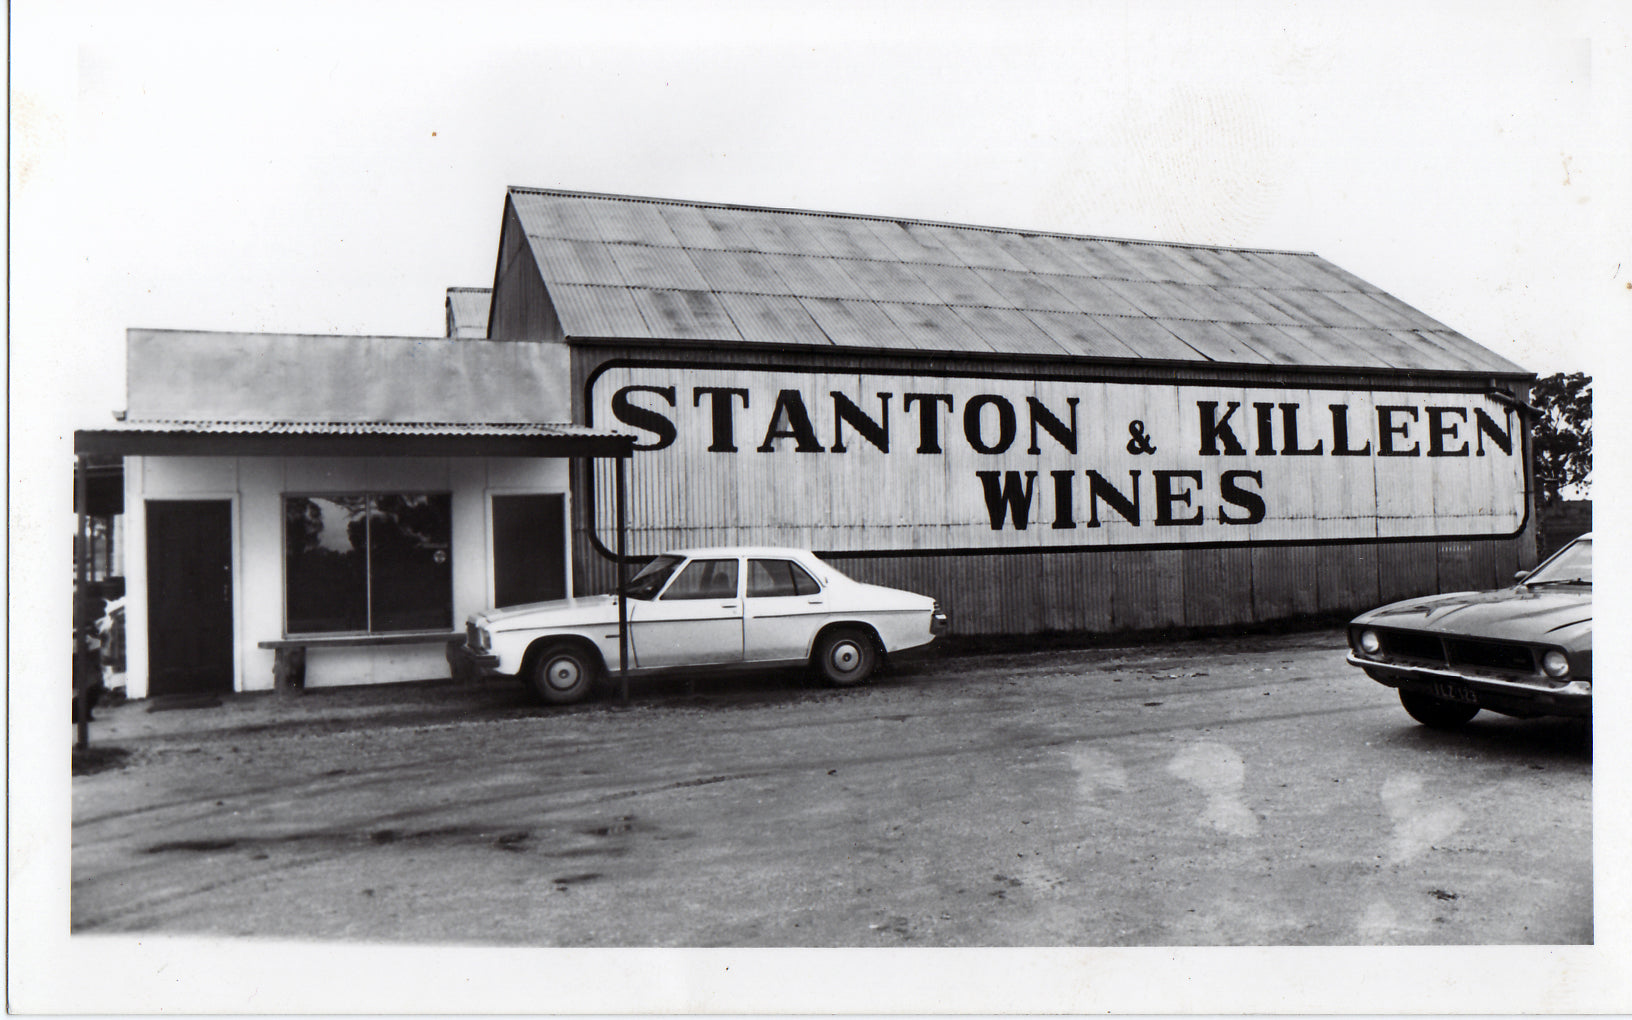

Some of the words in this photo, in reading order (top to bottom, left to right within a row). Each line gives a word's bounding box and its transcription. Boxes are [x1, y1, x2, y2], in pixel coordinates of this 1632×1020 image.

[611, 385, 1080, 456] STANTON
[1127, 420, 1157, 456] &
[1197, 401, 1513, 458] KILLEEN
[976, 469, 1267, 531] WINES
